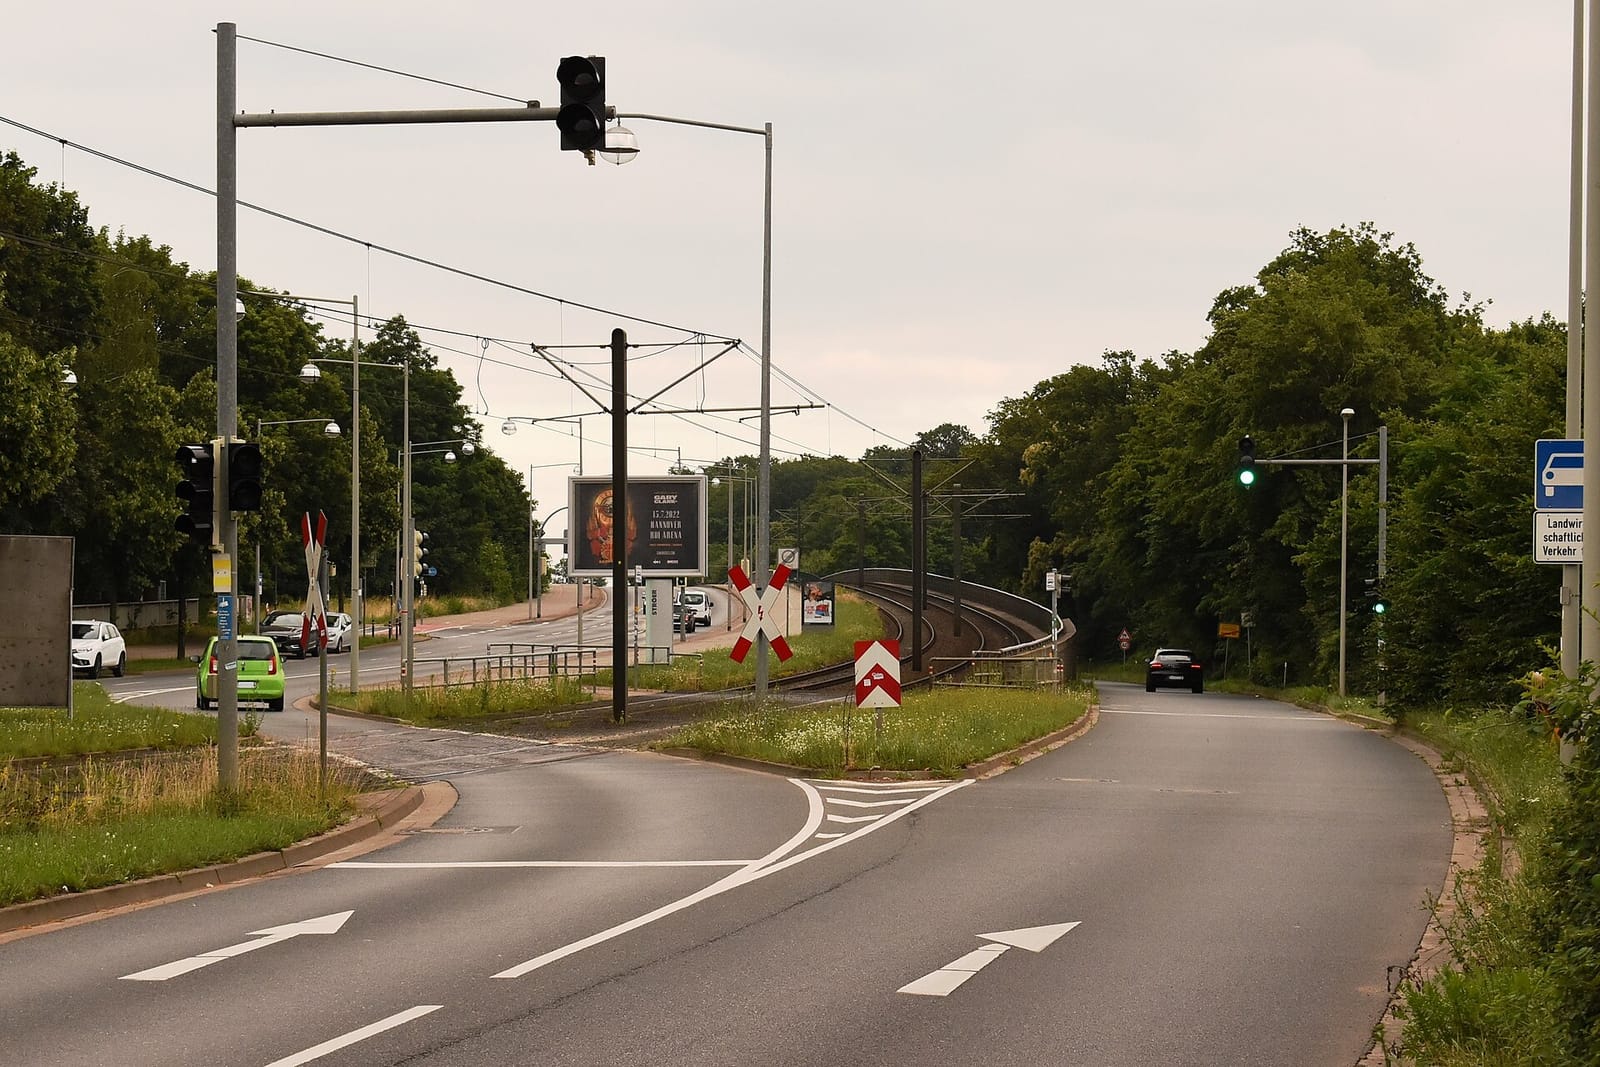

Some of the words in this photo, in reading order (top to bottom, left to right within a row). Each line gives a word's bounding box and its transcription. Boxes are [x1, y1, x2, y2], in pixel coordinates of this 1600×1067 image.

[652, 510, 680, 518] 15.7.2022
[650, 521, 682, 529] HANNOVER
[663, 531, 682, 539] ARENA
[1542, 545, 1577, 556] Verkehr
